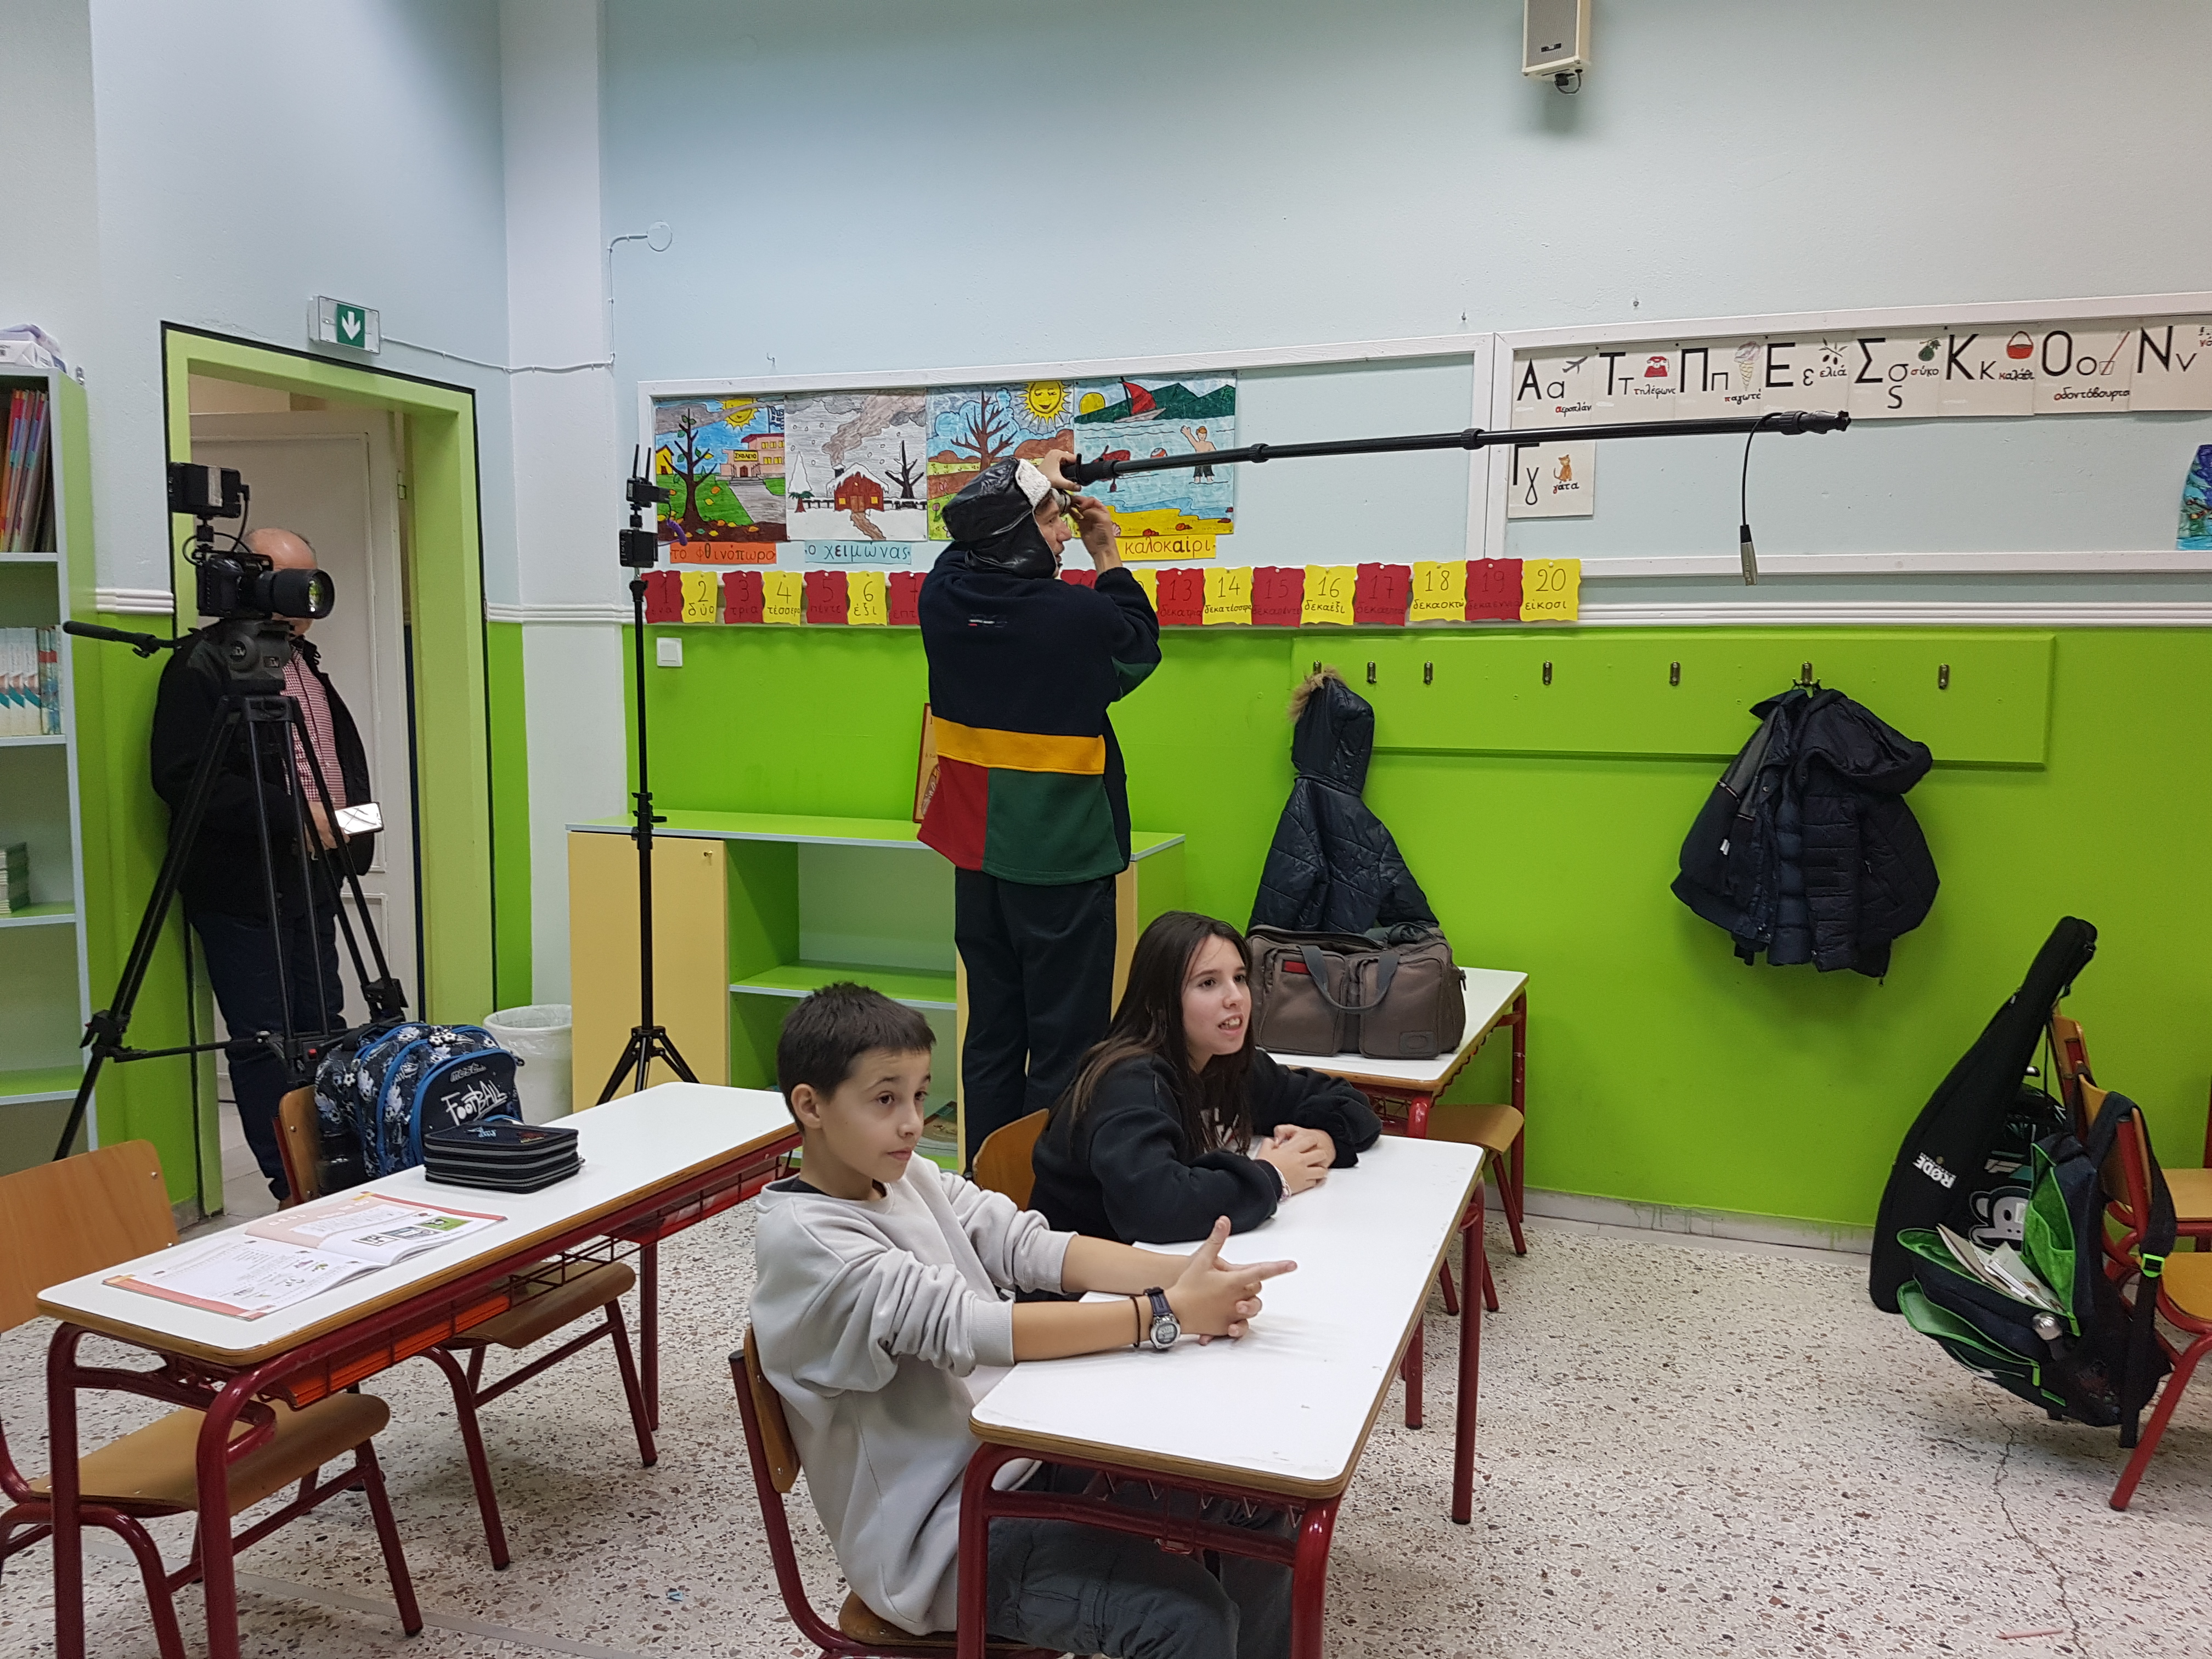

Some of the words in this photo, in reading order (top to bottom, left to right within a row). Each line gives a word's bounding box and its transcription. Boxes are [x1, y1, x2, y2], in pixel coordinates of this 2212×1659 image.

[1819, 364, 1847, 377] ελιά
[1910, 365, 1939, 377] σύκο
[1555, 402, 1592, 417] αεροπλάν
[1553, 481, 1580, 494] γάτα
[671, 549, 687, 560] το
[696, 543, 776, 563] φθινόπωρο
[808, 545, 816, 555] ο
[824, 541, 908, 562] χειμώνας
[1125, 536, 1211, 558] καλοκαίρι
[660, 578, 669, 603] 1
[698, 580, 708, 602] 2
[738, 579, 749, 602] 3
[822, 578, 833, 602] 5
[864, 580, 874, 602] 6
[905, 578, 918, 602] 7
[1169, 578, 1193, 601] 13
[1217, 575, 1241, 598] 14
[1264, 578, 1289, 599] 15
[1317, 576, 1341, 598] 16
[1368, 574, 1395, 599] 17
[1424, 570, 1451, 592] 18
[1481, 571, 1505, 594] 19
[1535, 568, 1566, 592] 20
[777, 580, 792, 604] 4
[688, 602, 714, 616] δύο
[811, 604, 841, 614] πέντε
[853, 602, 877, 617] έξι
[893, 610, 918, 619] επτ
[1305, 599, 1345, 614] δεκαέξι
[1413, 598, 1464, 610] δεκαοκτώ
[1525, 598, 1567, 610] είκοσι
[1911, 1155, 1955, 1189] RØDE
